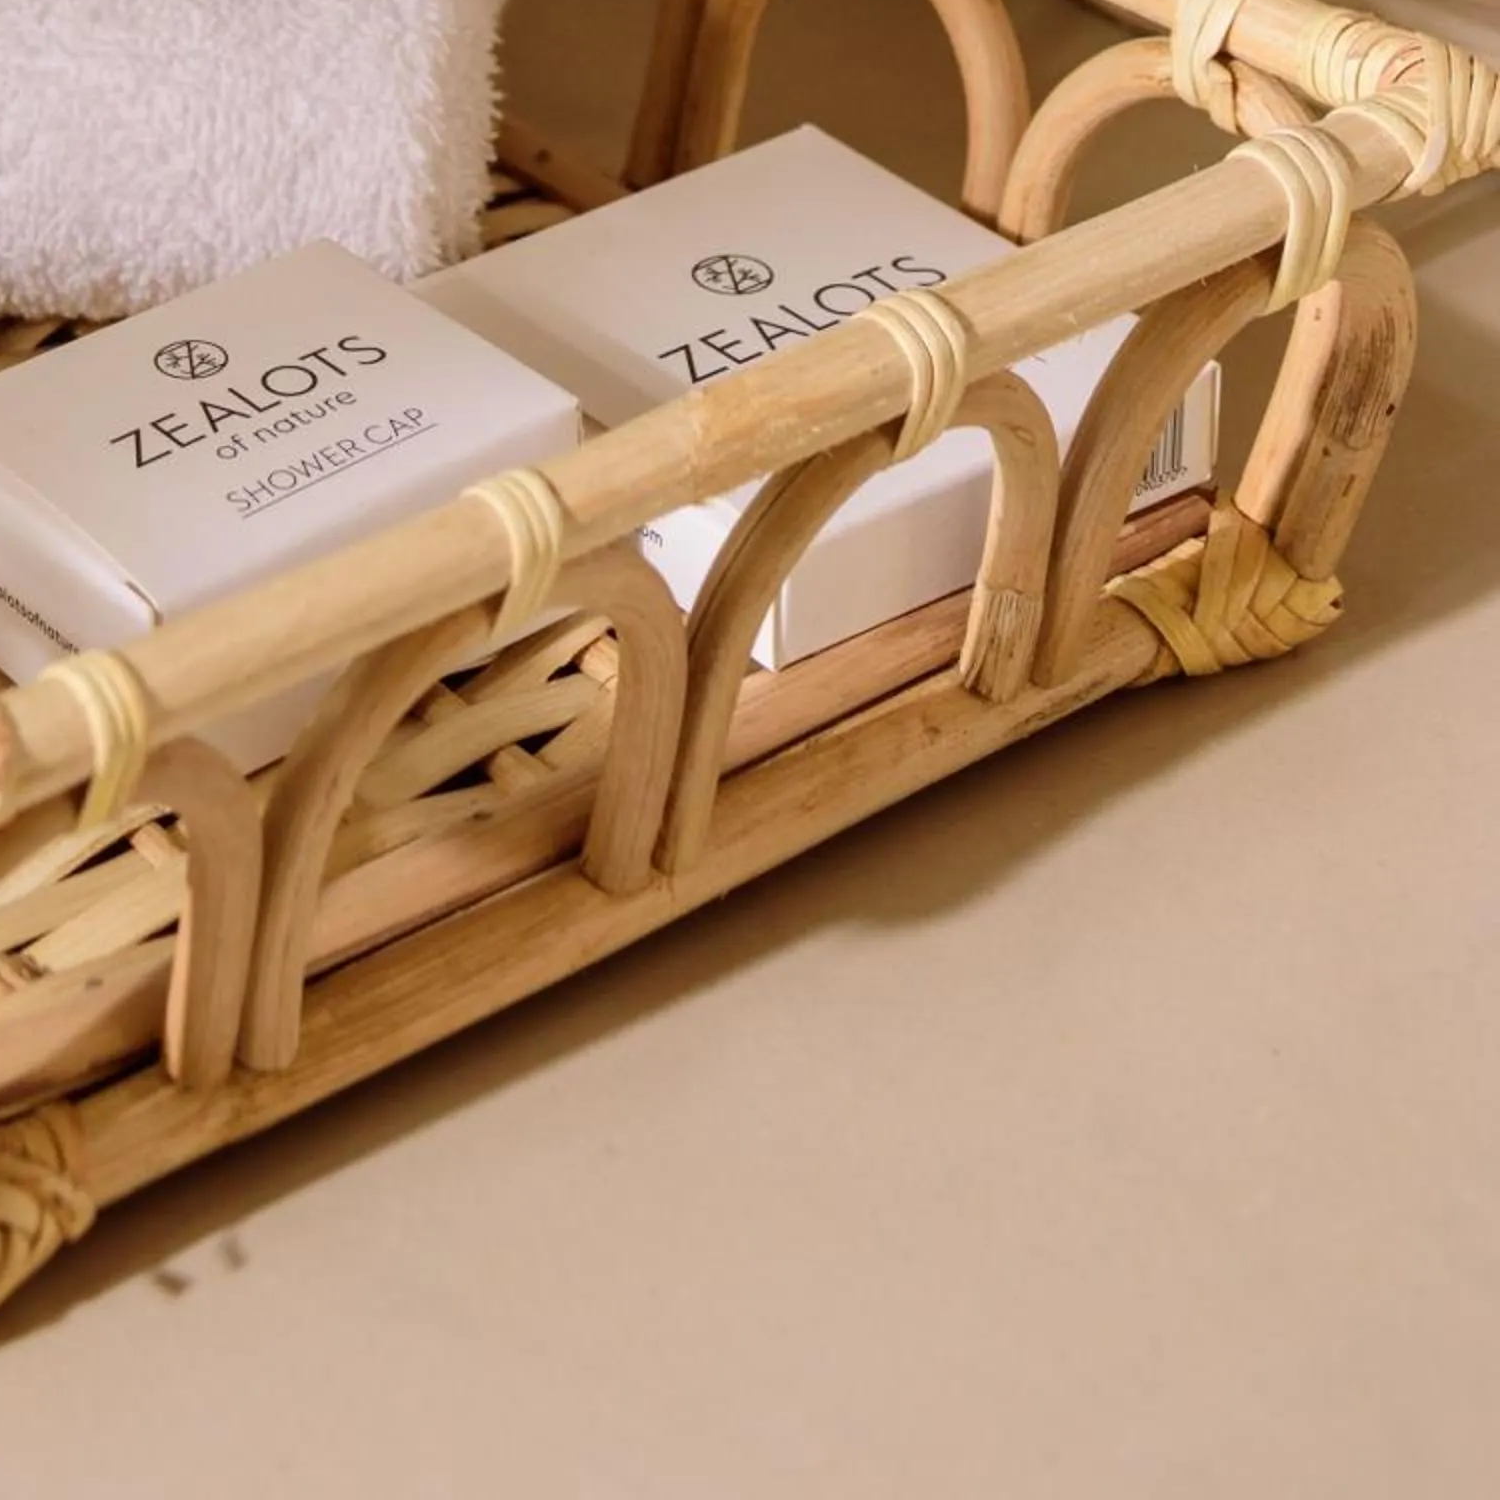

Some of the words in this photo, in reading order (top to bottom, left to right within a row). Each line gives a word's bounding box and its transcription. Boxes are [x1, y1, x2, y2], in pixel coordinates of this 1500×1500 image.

[658, 255, 947, 384] ZEALOTS
[109, 335, 387, 468] ZEALOTS
[216, 433, 249, 460] of
[252, 389, 357, 444] nature
[226, 438, 367, 513] SHOWER
[363, 406, 425, 447] CAP
